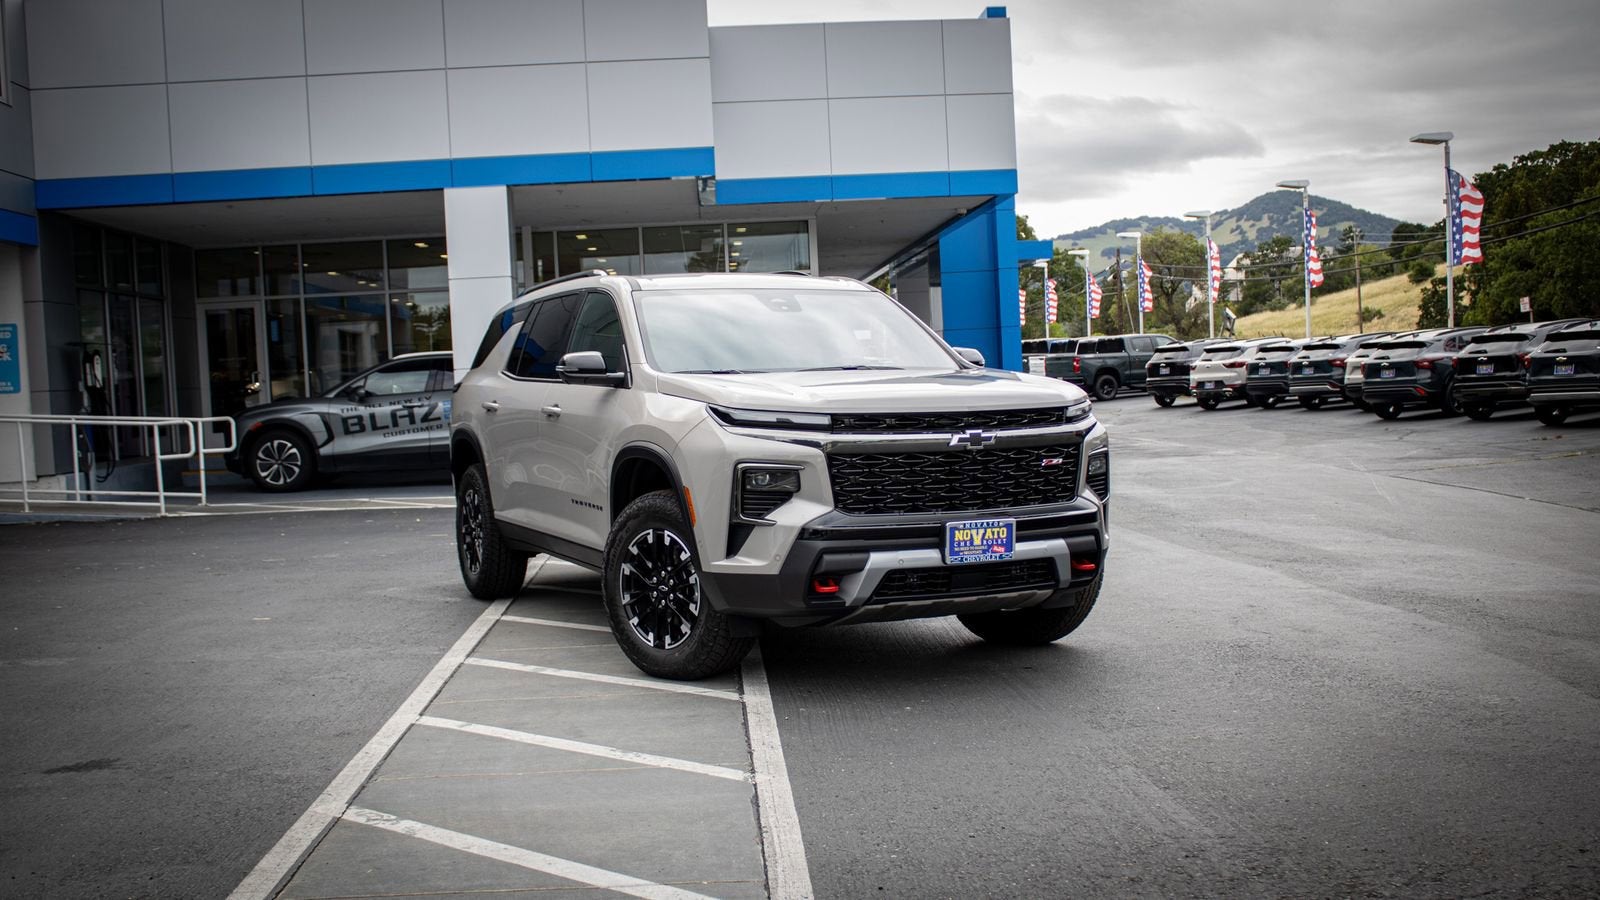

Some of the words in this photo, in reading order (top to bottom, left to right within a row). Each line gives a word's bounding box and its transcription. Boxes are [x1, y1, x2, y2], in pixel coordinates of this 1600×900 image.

[340, 406, 361, 414] THE
[364, 402, 385, 410] ALL
[389, 398, 413, 406] NEW
[383, 423, 443, 438] CUSTOMER
[954, 527, 1007, 546] NOVATO
[963, 553, 1001, 563] CHEVROLET
